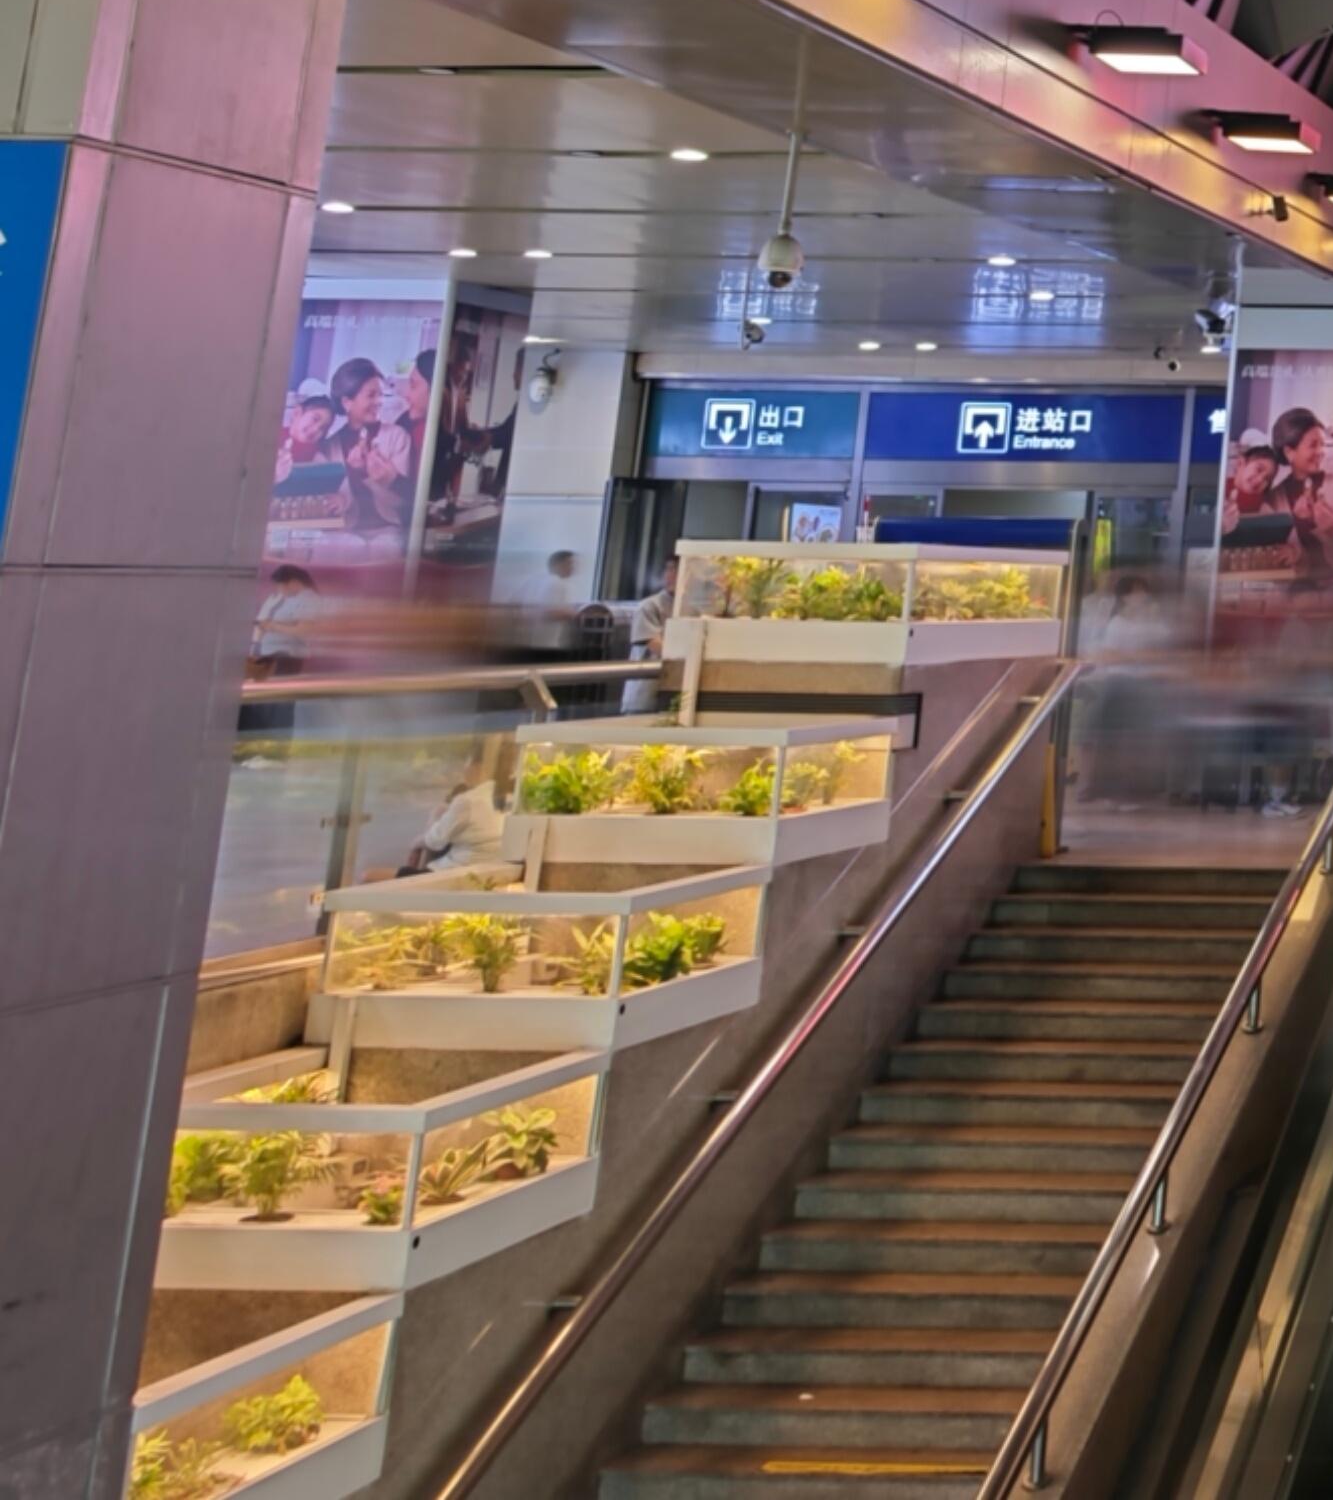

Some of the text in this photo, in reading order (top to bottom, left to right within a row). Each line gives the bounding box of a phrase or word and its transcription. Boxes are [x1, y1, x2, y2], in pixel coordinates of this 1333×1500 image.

[759, 404, 805, 428] 出口
[1015, 407, 1092, 433] 进站口
[757, 431, 784, 446] Exit
[1013, 434, 1076, 450] Entrance
